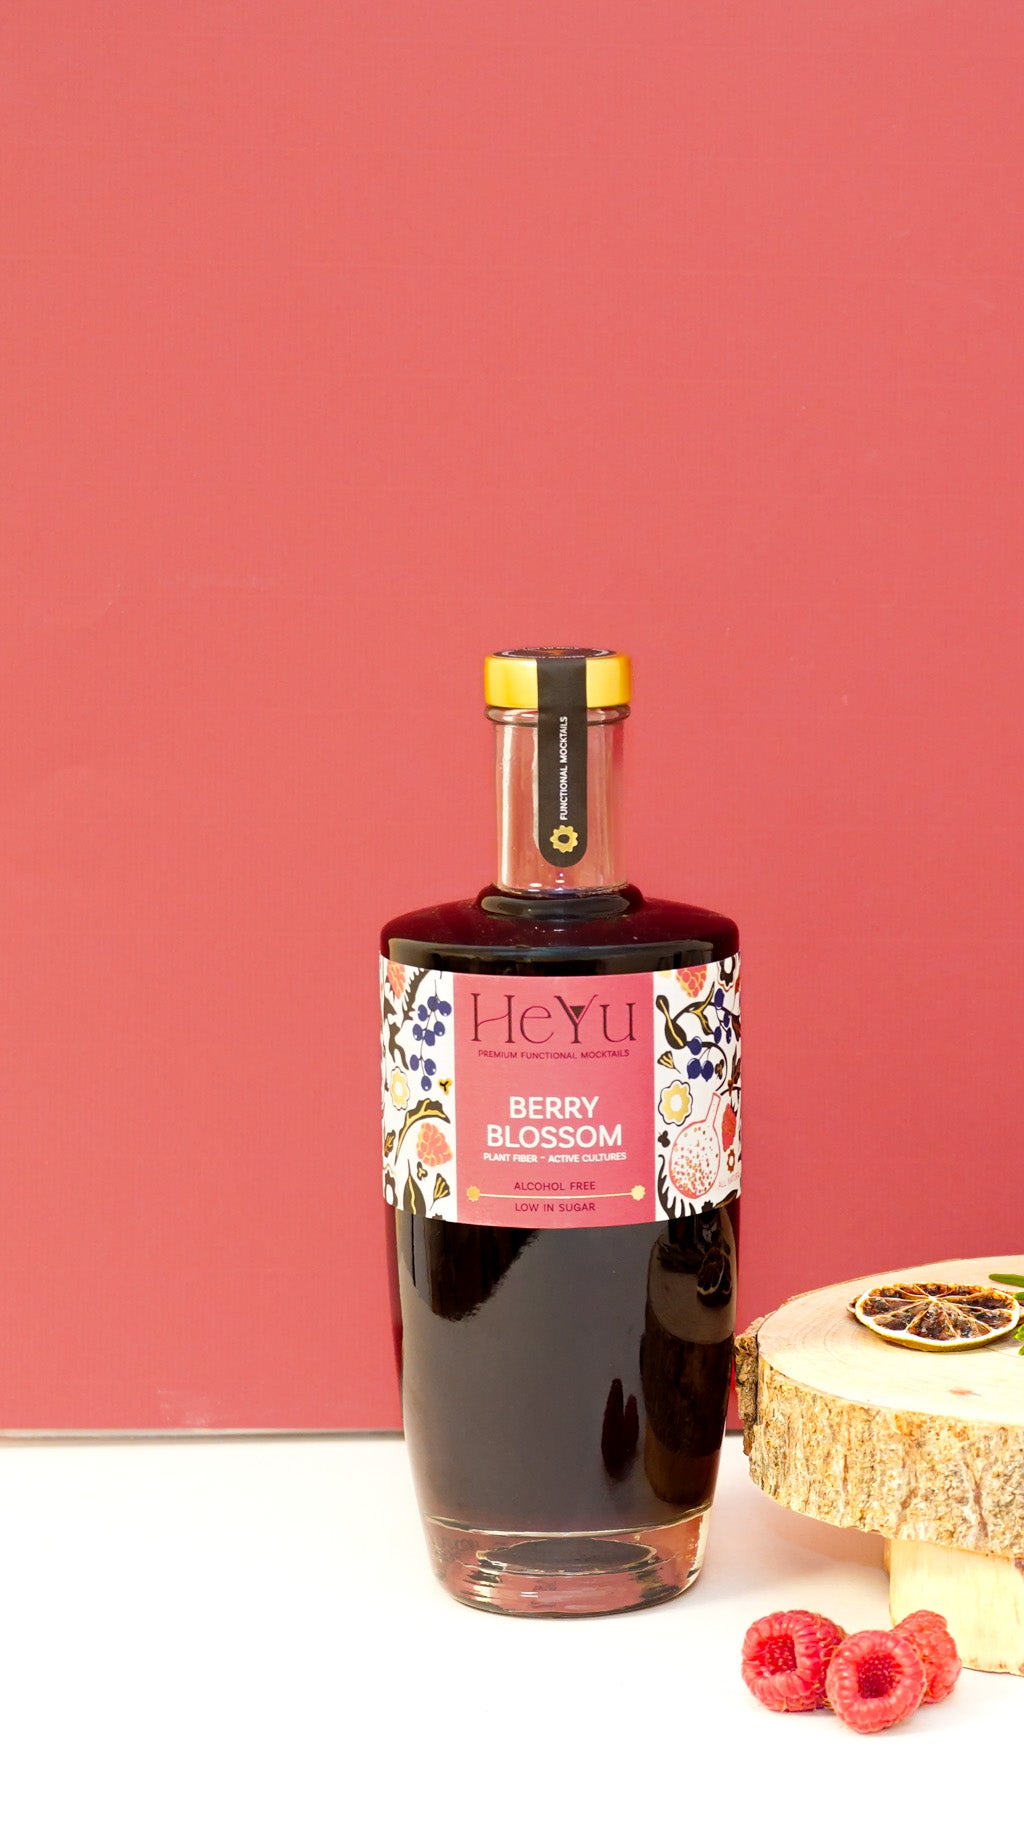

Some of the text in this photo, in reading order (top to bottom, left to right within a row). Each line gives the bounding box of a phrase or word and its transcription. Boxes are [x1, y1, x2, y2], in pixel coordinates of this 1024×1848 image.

[559, 716, 568, 820] FUNCTIONAL MOCKTAILS
[471, 993, 637, 1044] HeYu
[478, 1049, 630, 1060] PREMIUM FUNCTIONAL MOCKTAILS
[509, 1096, 599, 1120] BERRY
[487, 1123, 622, 1149] BLOSSOM
[483, 1152, 511, 1162] PLANT
[513, 1154, 538, 1163] FIBER
[548, 1154, 580, 1163] ACTIVE
[582, 1152, 627, 1163] CULTURES
[514, 1181, 596, 1191] ALCOHOL FREE
[515, 1203, 596, 1212] LOW IN SUGAR
